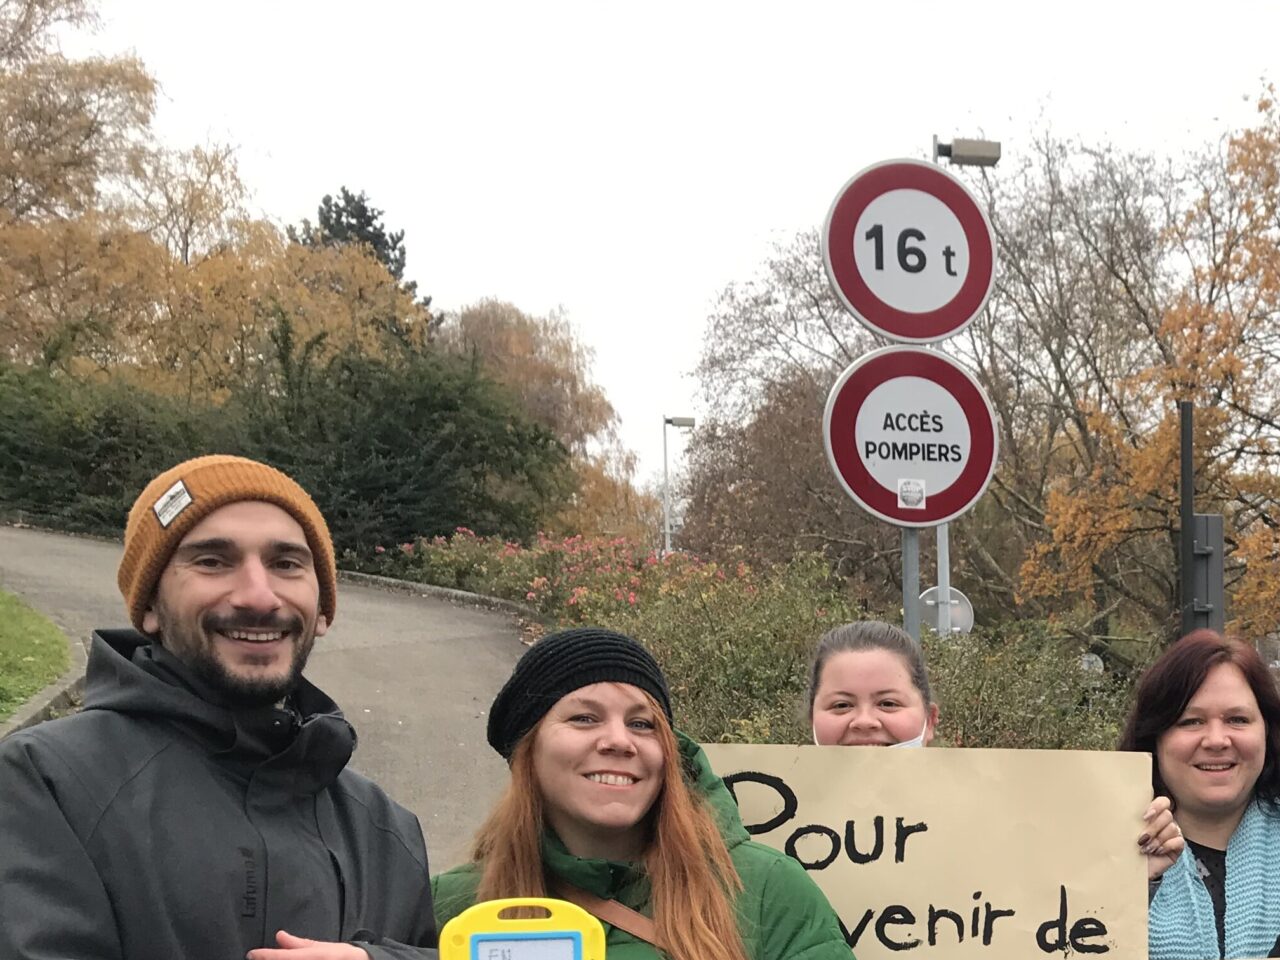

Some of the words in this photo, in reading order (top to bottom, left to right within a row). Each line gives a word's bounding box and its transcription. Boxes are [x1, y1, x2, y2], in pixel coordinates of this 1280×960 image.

[865, 224, 927, 273] 16
[942, 244, 957, 277] t
[883, 410, 943, 433] ACCÈS
[865, 441, 962, 462] POMPIERS
[723, 771, 927, 870] Pour
[1036, 885, 1109, 957] de
